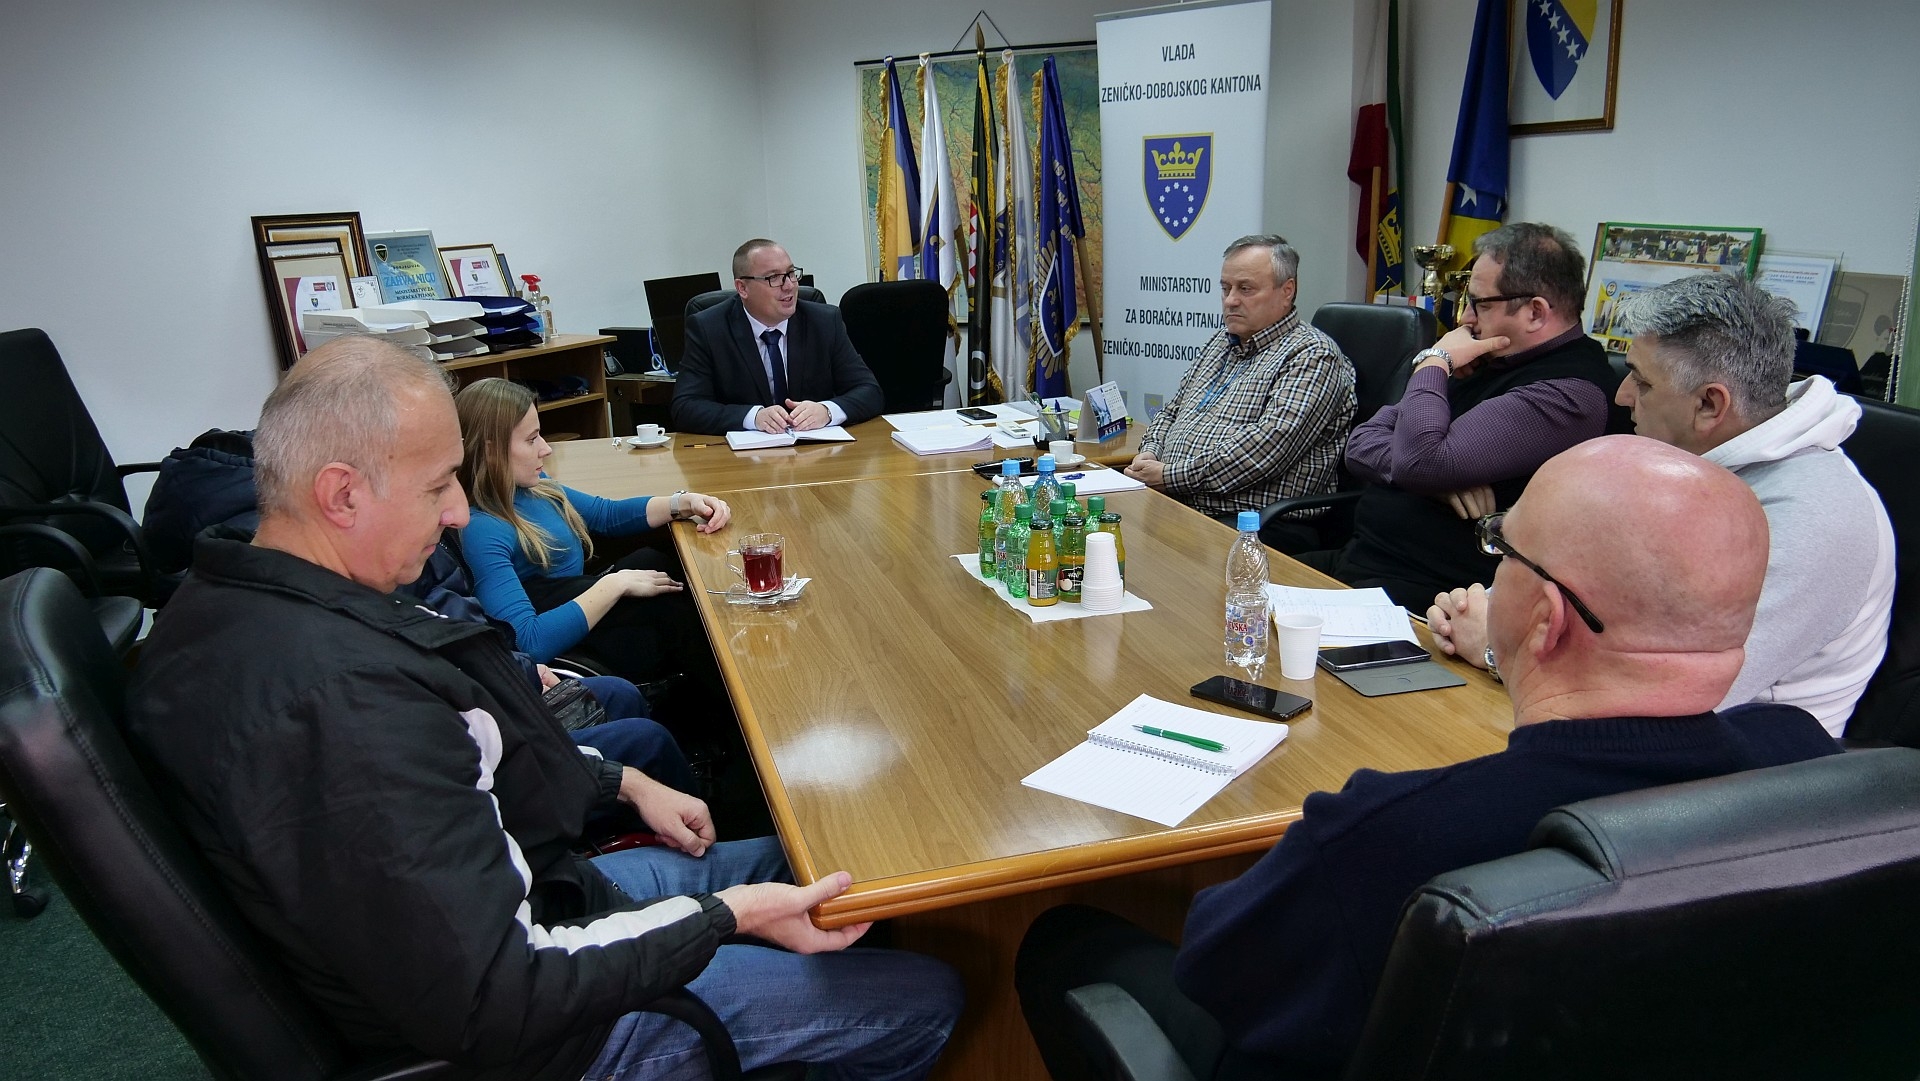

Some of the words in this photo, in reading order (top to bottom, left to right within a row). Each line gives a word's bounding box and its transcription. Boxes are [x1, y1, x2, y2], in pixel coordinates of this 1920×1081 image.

[1161, 43, 1196, 63] VLADA
[1101, 78, 1207, 103] ZENIČKO-DOBOJSKOG
[1211, 74, 1262, 95] KANTONA
[384, 272, 436, 288] ZAHVALNICU
[1140, 276, 1211, 294] MINISTARSTVO
[1125, 308, 1137, 324] ZA
[1140, 307, 1183, 327] BORAČKA
[1186, 312, 1226, 329] PITANJA
[1104, 424, 1121, 437] ASKA
